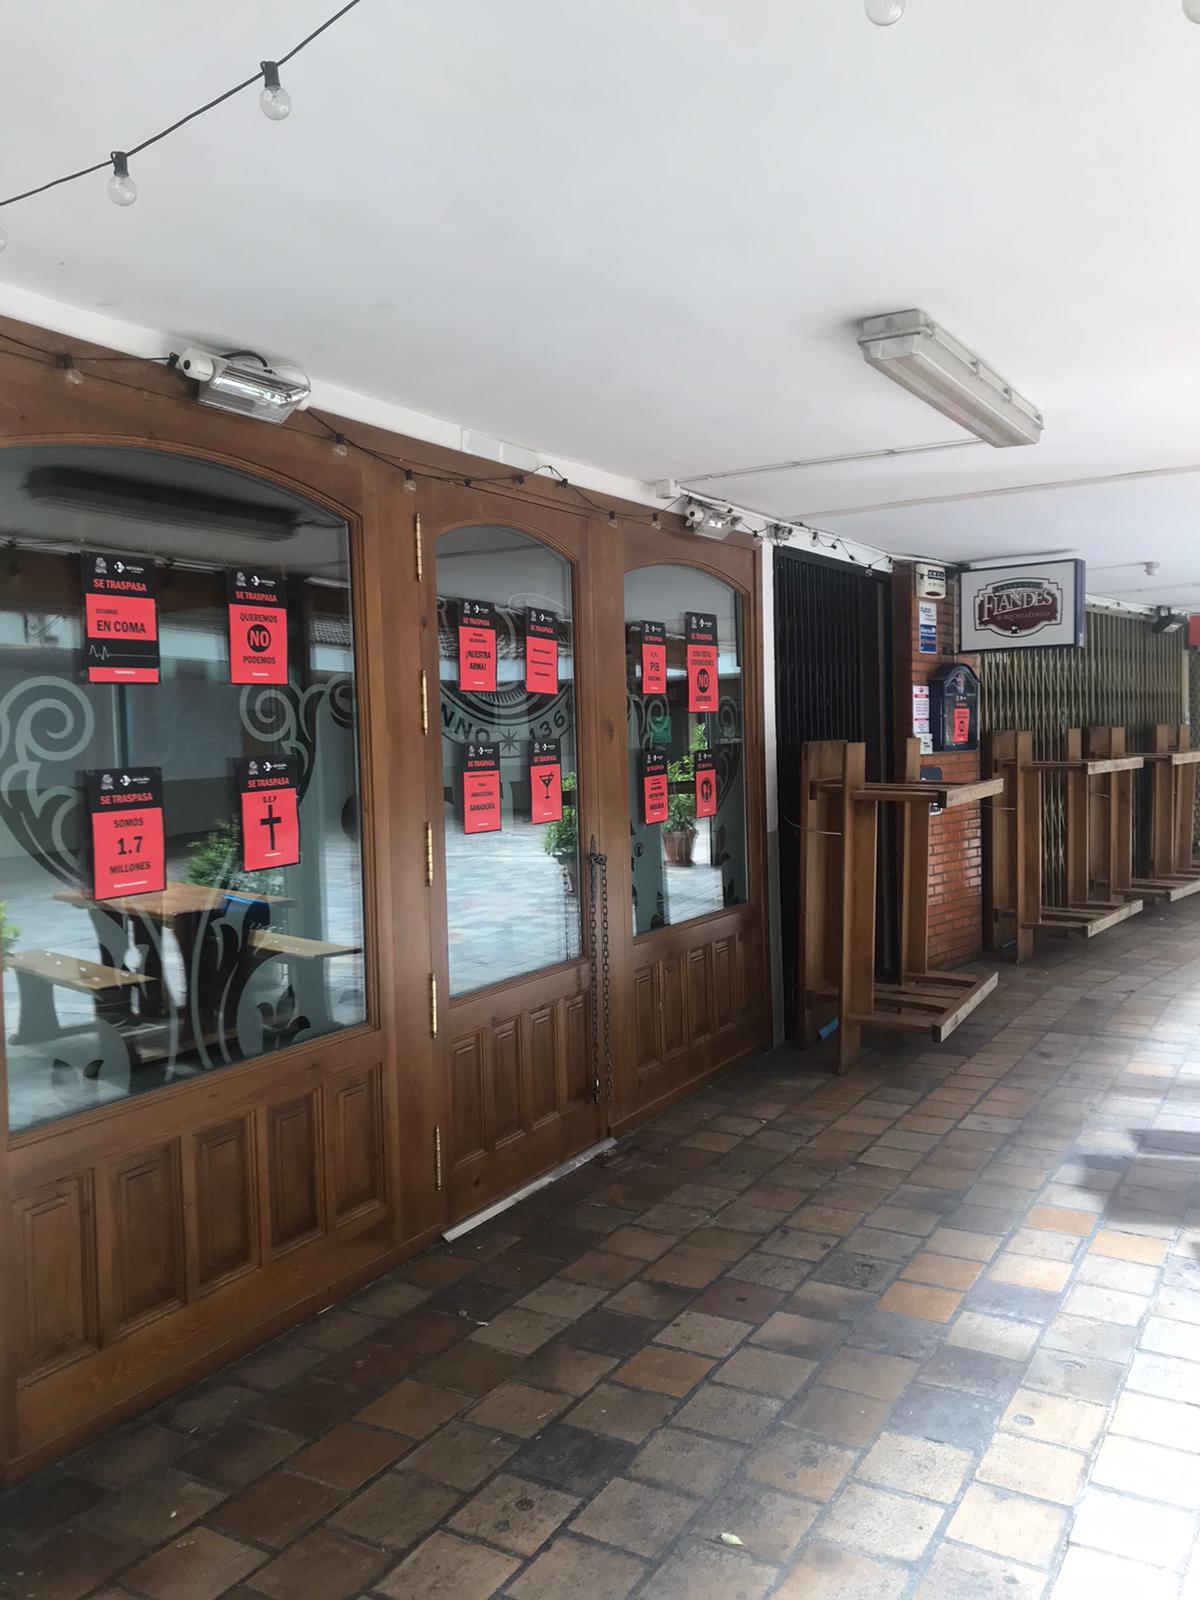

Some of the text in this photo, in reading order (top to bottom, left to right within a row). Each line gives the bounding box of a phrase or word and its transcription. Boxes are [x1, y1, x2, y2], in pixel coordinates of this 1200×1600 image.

[93, 579, 147, 592] SE TRASPASA
[235, 591, 277, 602] SE TRASPASA
[981, 588, 1053, 621] FLANDES
[240, 613, 278, 623] QUEREMOS
[96, 620, 146, 633] EN COMA
[249, 630, 270, 647] NO
[243, 656, 276, 665] PODEMOS
[698, 673, 708, 688] NO
[441, 703, 491, 742] NNO
[248, 778, 289, 789] SE TRASPASA
[100, 793, 153, 805] SE TRASPASA
[113, 817, 144, 829] SOMOS
[117, 836, 143, 855] 1.7
[109, 861, 151, 875] MILLONES
